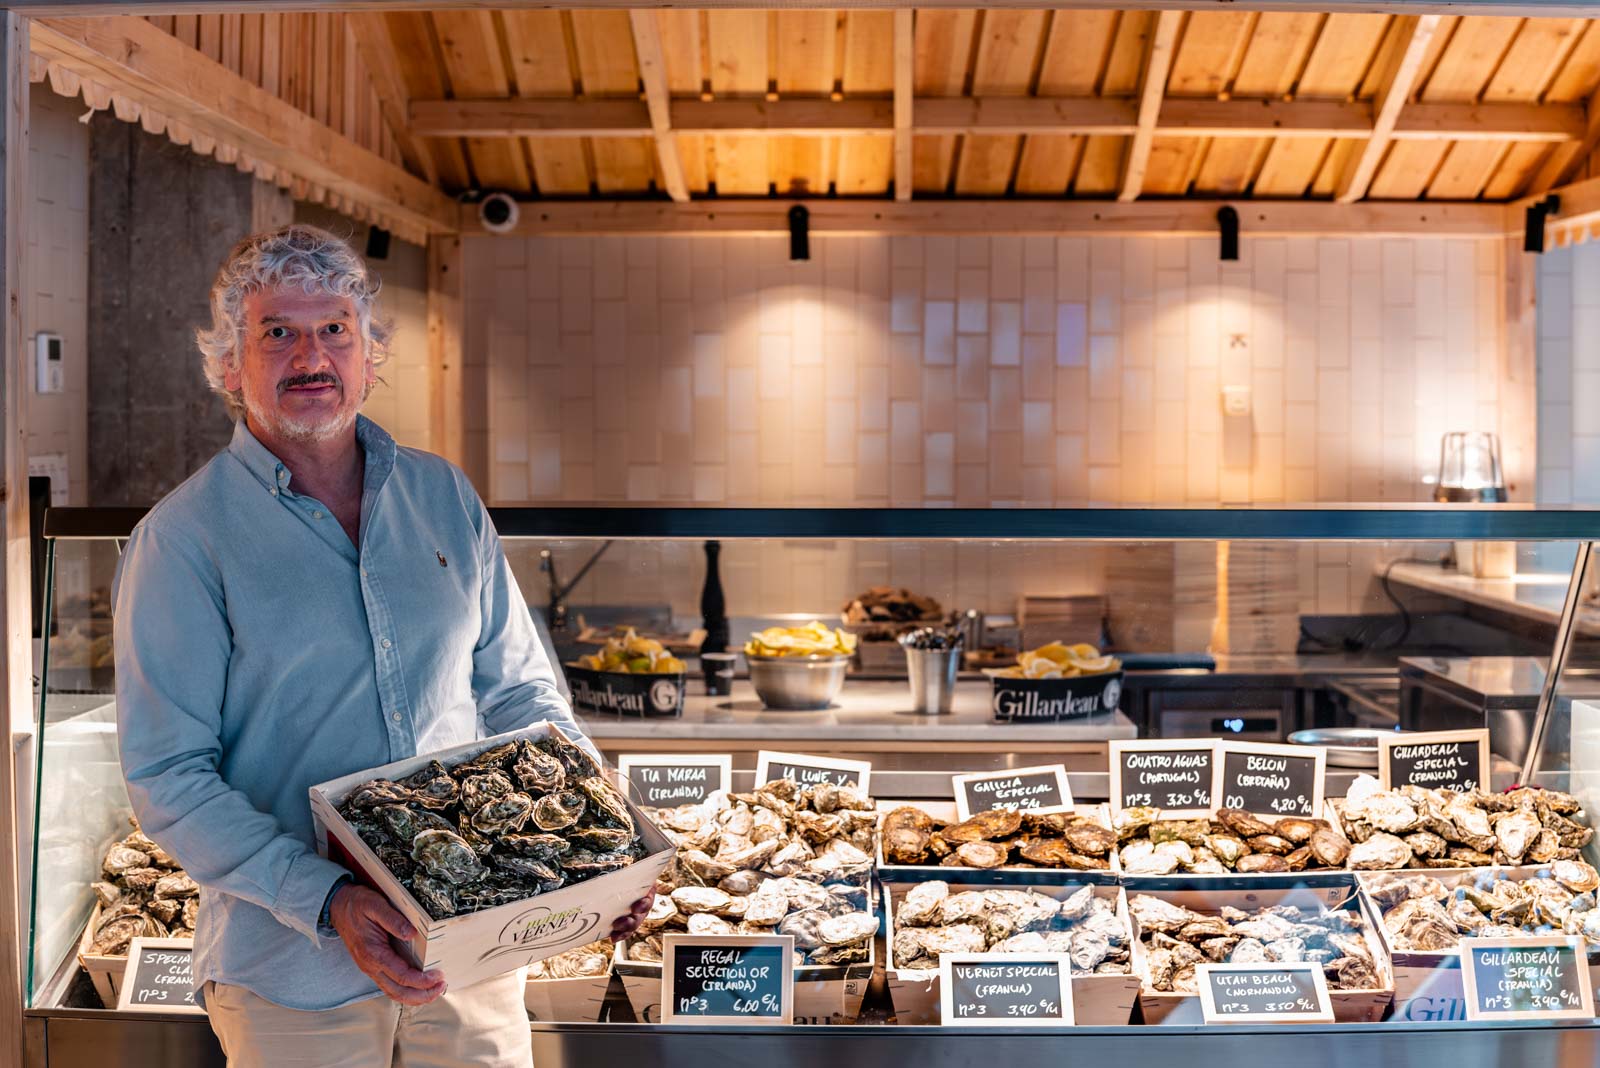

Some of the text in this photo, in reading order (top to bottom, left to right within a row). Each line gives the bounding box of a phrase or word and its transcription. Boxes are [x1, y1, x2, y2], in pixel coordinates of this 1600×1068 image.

[995, 689, 1099, 717] Gillardeau
[1127, 754, 1208, 768] QUATRO AGUAS
[1247, 756, 1287, 772] BELON
[1413, 757, 1468, 770] SPECIAL
[641, 768, 660, 783] TIA
[801, 770, 831, 783] LUNE
[1139, 770, 1200, 784] (PORTUGAL)
[1237, 774, 1290, 790] (BRETAÑA)
[974, 777, 1022, 792] GALICIA
[996, 784, 1053, 798] ESPECIAL
[649, 785, 704, 801] (IRLANDA)
[513, 911, 582, 942] VERNET
[144, 953, 193, 964] SPECIA
[701, 950, 745, 965] REGAL
[1480, 951, 1560, 967] GILLARDEAU
[686, 966, 770, 979] SELECTION OR
[956, 966, 1058, 979] VERNET SPECIAL
[1504, 965, 1563, 978] SPECIAL
[702, 979, 757, 993] (IRLANDA)
[1216, 974, 1292, 986] UTAH BEACH
[1499, 979, 1553, 991] (FRANCIA)
[1226, 986, 1297, 997] (NORMANDIA)
